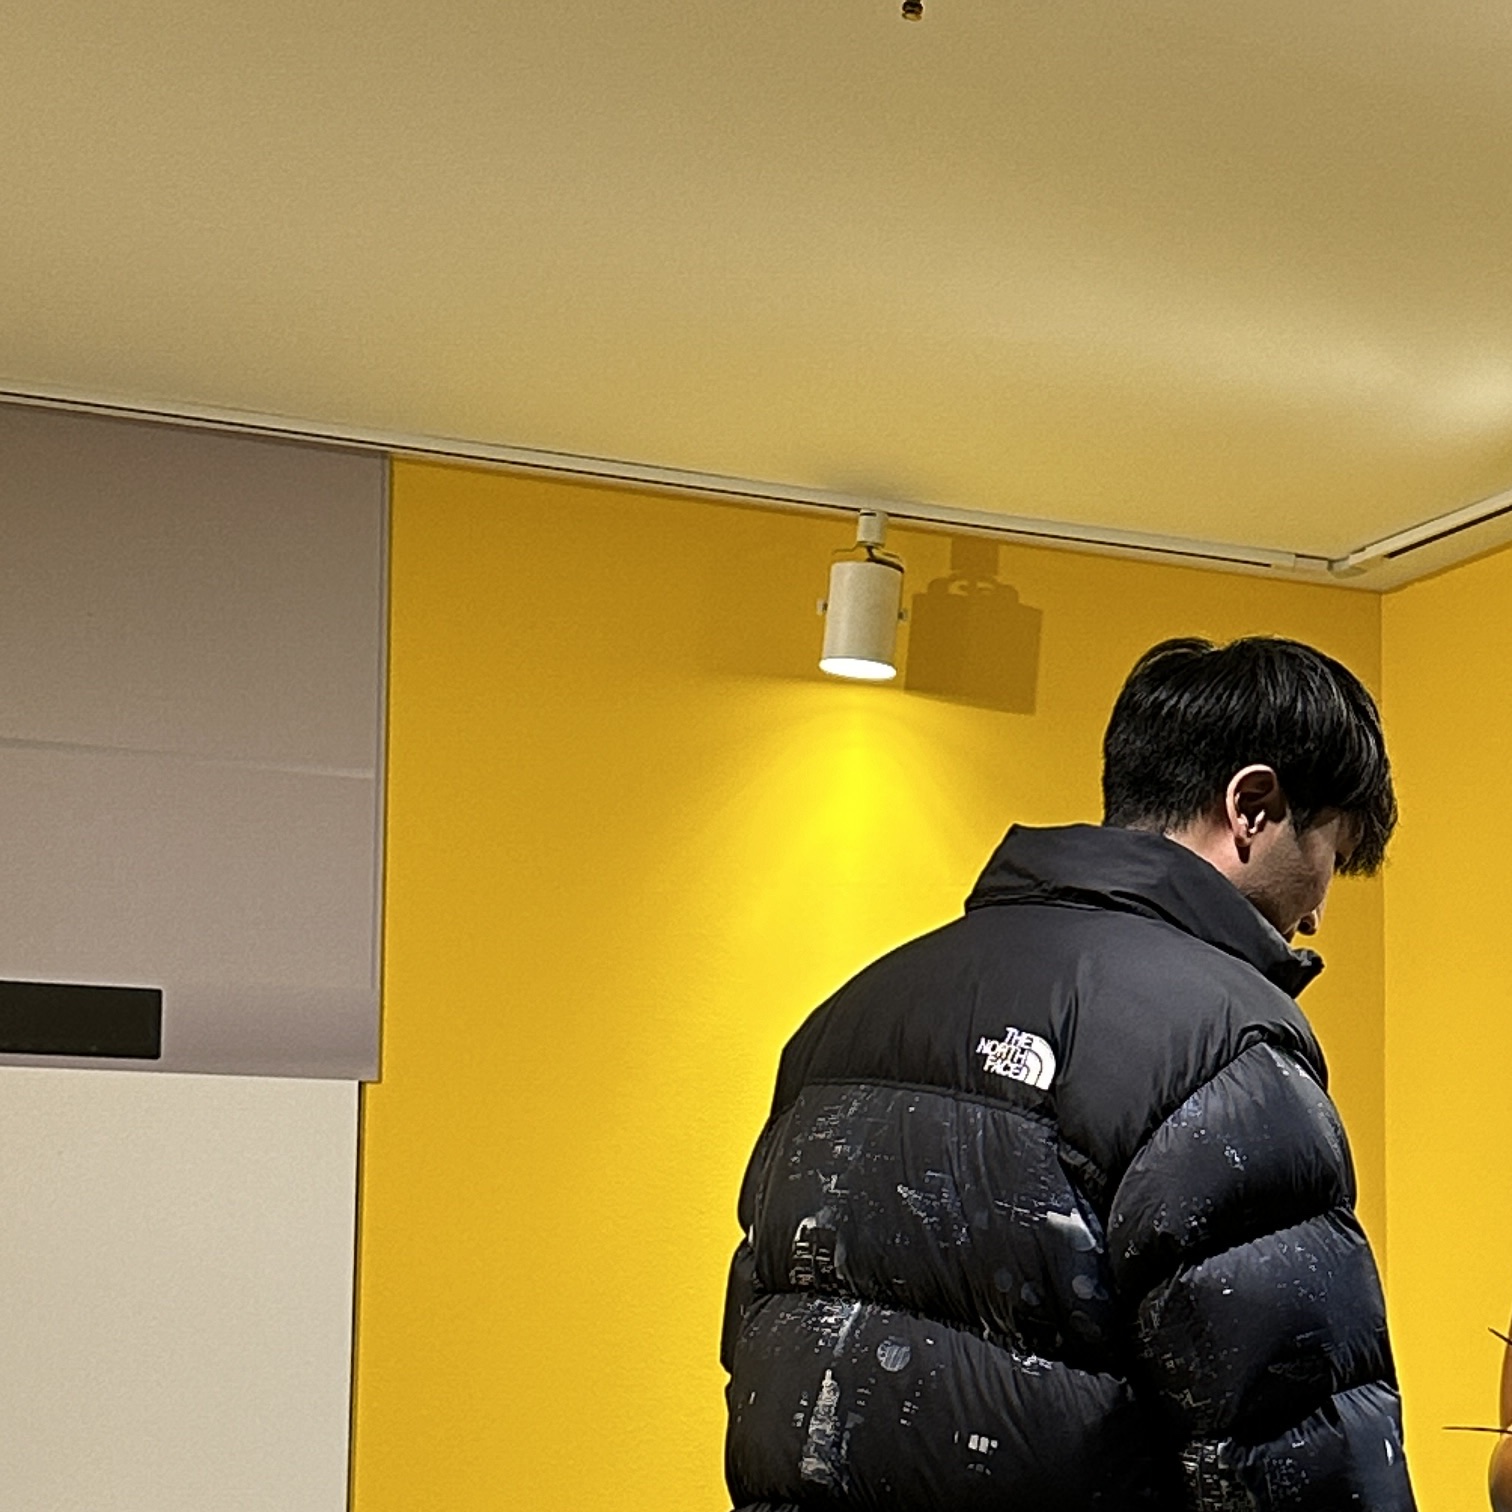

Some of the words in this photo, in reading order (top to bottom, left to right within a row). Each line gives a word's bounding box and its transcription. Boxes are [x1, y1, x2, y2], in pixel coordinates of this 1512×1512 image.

[975, 1036, 1024, 1065] NORTH
[1004, 1027, 1034, 1049] THE
[983, 1054, 1023, 1080] FACE
